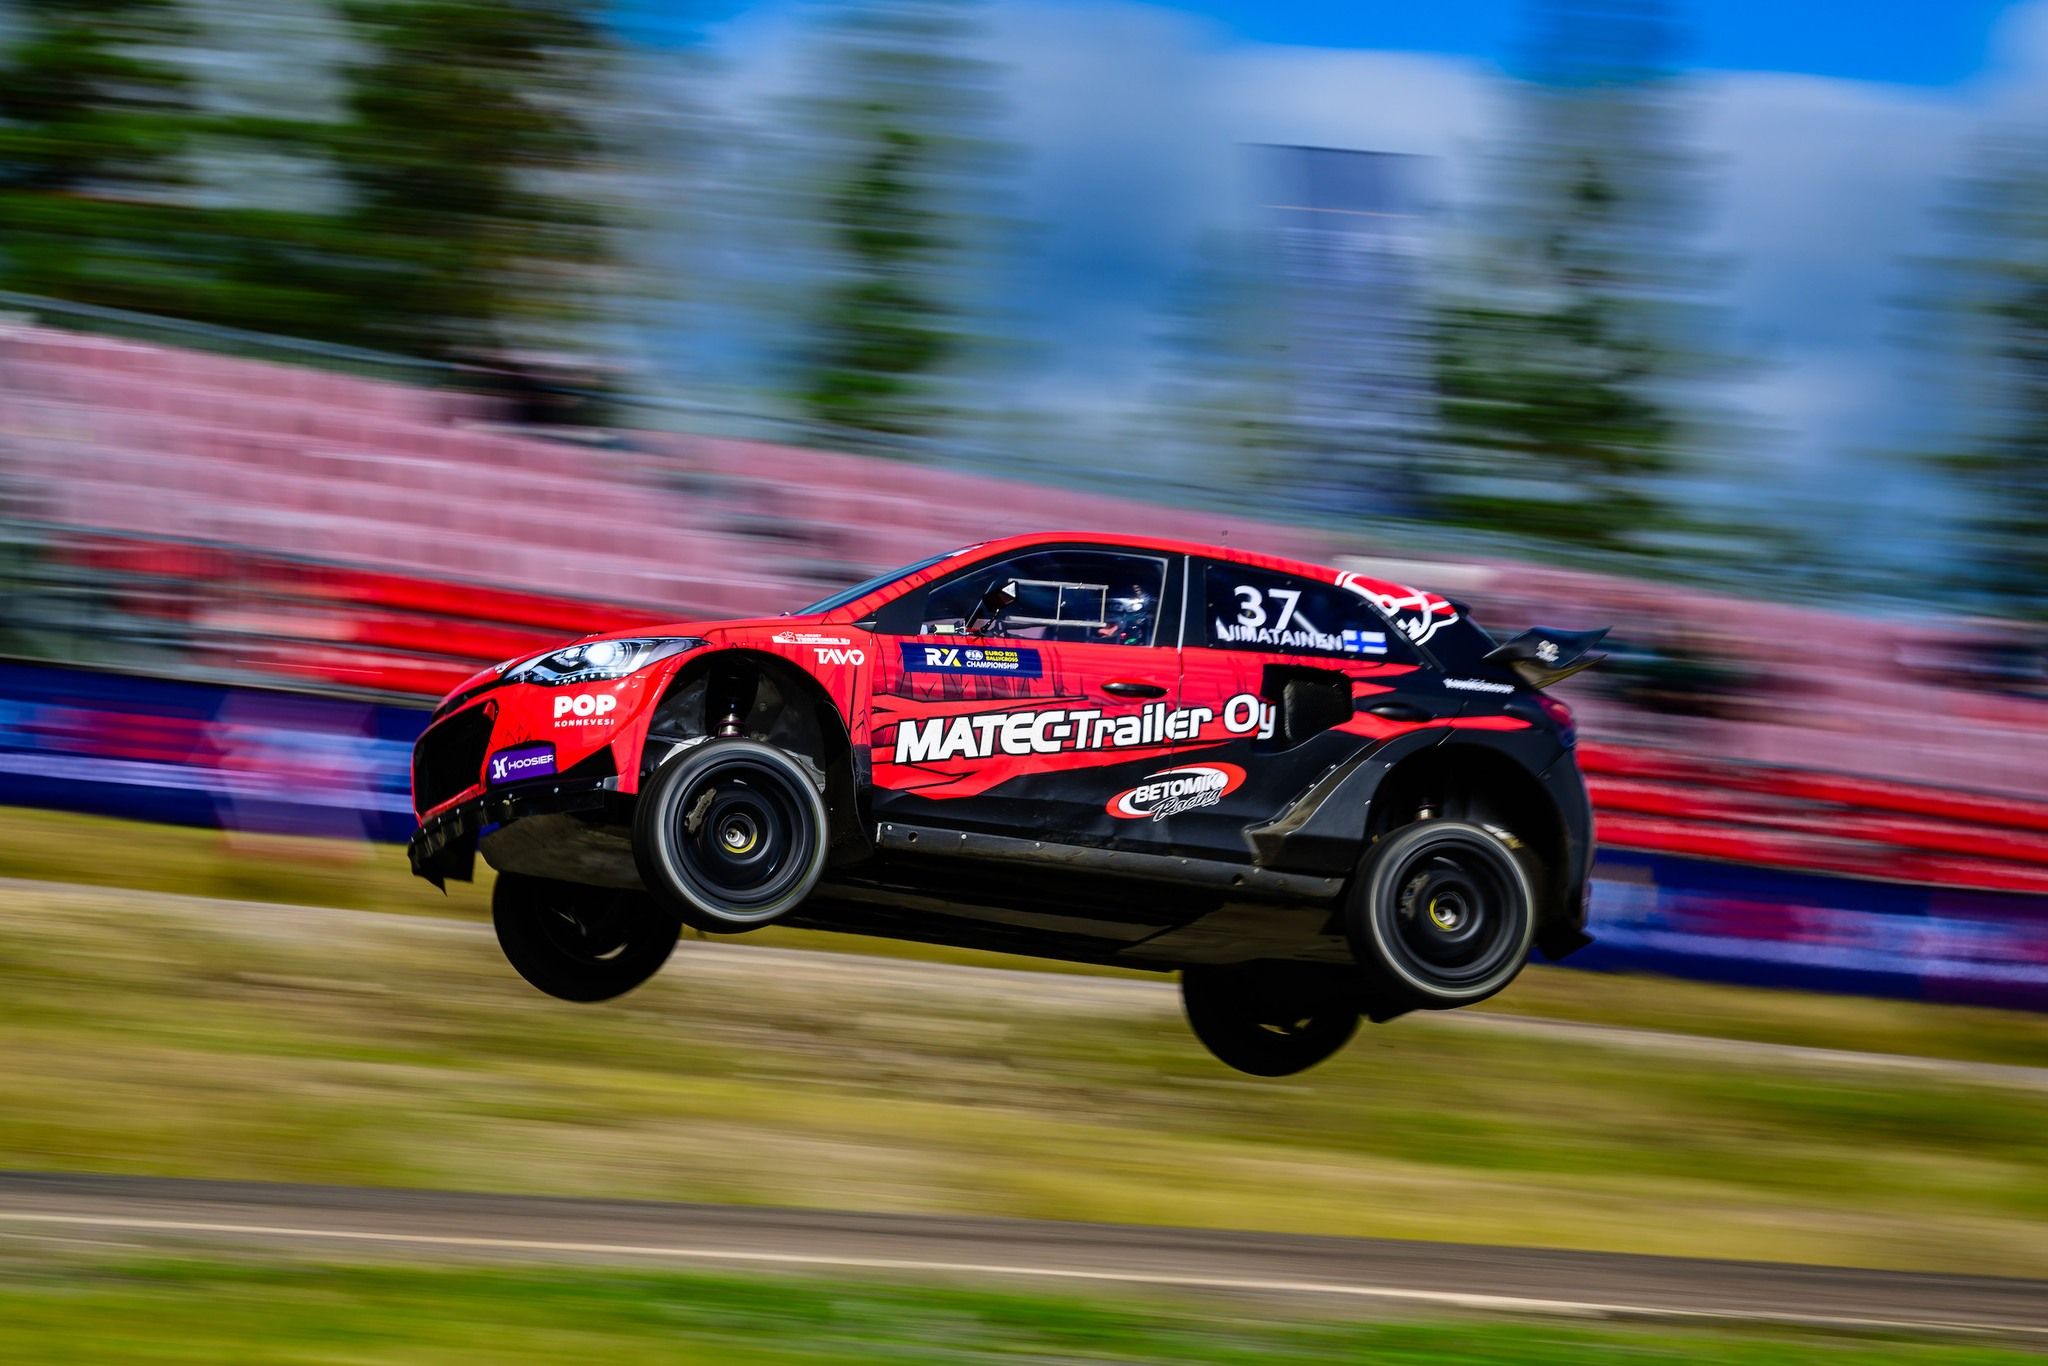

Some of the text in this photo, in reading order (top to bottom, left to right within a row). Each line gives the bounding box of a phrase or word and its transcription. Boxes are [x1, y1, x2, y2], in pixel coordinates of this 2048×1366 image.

[1234, 585, 1302, 631] 37
[813, 648, 865, 666] TAVO
[924, 648, 962, 667] RX
[966, 661, 1019, 669] CHAMPIONSHIP
[554, 694, 617, 719] POP
[554, 718, 615, 728] KONNEVESI
[895, 694, 1276, 764] MATEC-Trailer Oy
[508, 754, 555, 771] HOOSIER
[1134, 773, 1222, 804] BETOMIK
[1149, 786, 1224, 822] Racing
